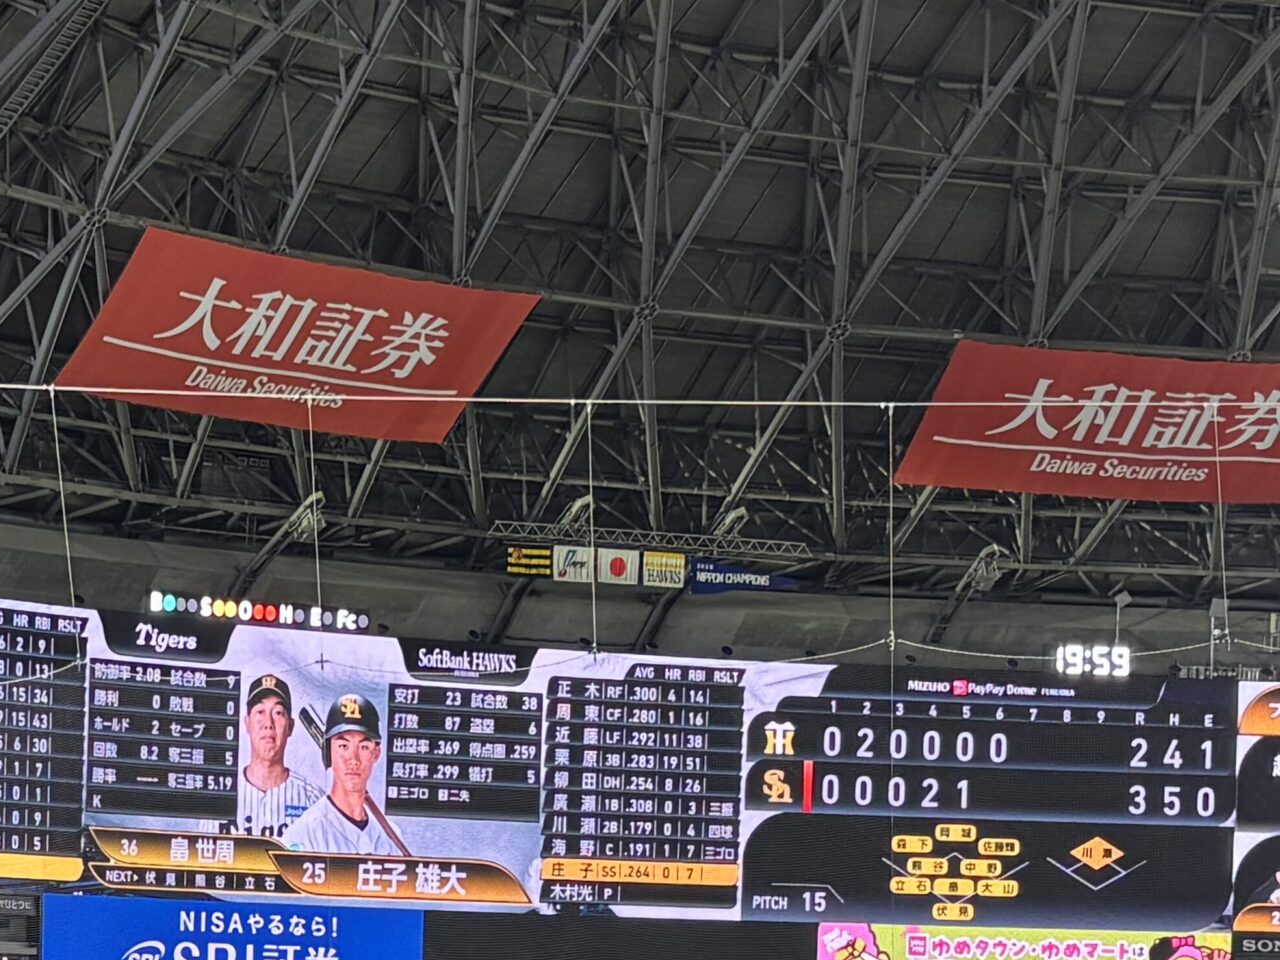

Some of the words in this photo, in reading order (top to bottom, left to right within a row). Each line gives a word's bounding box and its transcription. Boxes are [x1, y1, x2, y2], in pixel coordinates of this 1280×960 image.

[153, 277, 450, 378] 大和証券
[185, 365, 245, 393] Daiwa
[247, 376, 347, 408] Securities
[1030, 453, 1094, 476] Daiwa
[1099, 459, 1209, 482] Securities
[647, 569, 682, 584] HAWKS
[696, 572, 723, 584] NIPPON
[725, 573, 769, 586] CHAMPIONS
[16, 637, 23, 650] 2
[39, 640, 46, 653] 9
[136, 623, 197, 652] Tigers
[419, 648, 470, 670] SoftBank
[471, 652, 516, 673] HAWKS
[1056, 645, 1130, 676] 19:59
[228, 676, 235, 689] 9
[634, 667, 655, 679] AVG
[665, 668, 681, 680] HR
[689, 669, 706, 681] RBI
[713, 671, 738, 683] RSLT
[394, 688, 419, 704] 安打
[446, 692, 461, 706] 23
[522, 697, 537, 710] 38
[557, 680, 600, 699] 正木
[608, 687, 622, 698] RF
[630, 687, 657, 701] .300
[668, 690, 676, 702] 4
[689, 691, 703, 704] 14
[908, 680, 950, 692] MIZUHO
[968, 683, 1005, 696] PayPay
[1007, 684, 1037, 696] Dome
[831, 701, 836, 713] 1
[863, 702, 870, 714] 2
[896, 703, 904, 715] 3
[929, 704, 937, 717] 4
[963, 706, 970, 719] 5
[996, 707, 1004, 720] 6
[1030, 708, 1038, 722] 7
[1063, 710, 1071, 722] 8
[1097, 711, 1105, 723] 9
[1135, 712, 1145, 725] R
[1170, 714, 1179, 726] H
[1204, 714, 1214, 727] E
[824, 726, 841, 756] 0
[857, 728, 874, 757] 2
[890, 729, 907, 759] 0
[923, 730, 940, 760] 0
[956, 732, 974, 762] 0
[990, 733, 1007, 763] 0
[1130, 738, 1147, 767] 2
[1163, 739, 1182, 769] 4
[1201, 740, 1212, 769] 1
[822, 775, 839, 804] 0
[855, 776, 872, 805] 0
[888, 777, 905, 807] 0
[921, 778, 939, 807] 2
[957, 780, 968, 809] 1
[1129, 785, 1146, 815] 3
[1163, 786, 1181, 816] 5
[1197, 787, 1215, 817] 0
[120, 839, 138, 856] 36
[196, 838, 234, 865] 世周
[552, 839, 595, 856] 海野
[605, 844, 613, 855] C
[624, 844, 650, 857] .191
[664, 846, 669, 858] 1
[687, 846, 694, 858] 7
[705, 847, 734, 860] 三ゴロ
[302, 862, 325, 883] 25
[357, 861, 407, 892] 庄子
[416, 863, 467, 895] 雄大
[895, 880, 927, 891] 立石
[982, 883, 1014, 894] 大山
[752, 896, 787, 910] PITCH
[803, 891, 826, 911] 15
[179, 911, 339, 937] NISAやるなら!
[932, 939, 1144, 959] ゆめタウン・ゆめマートは
